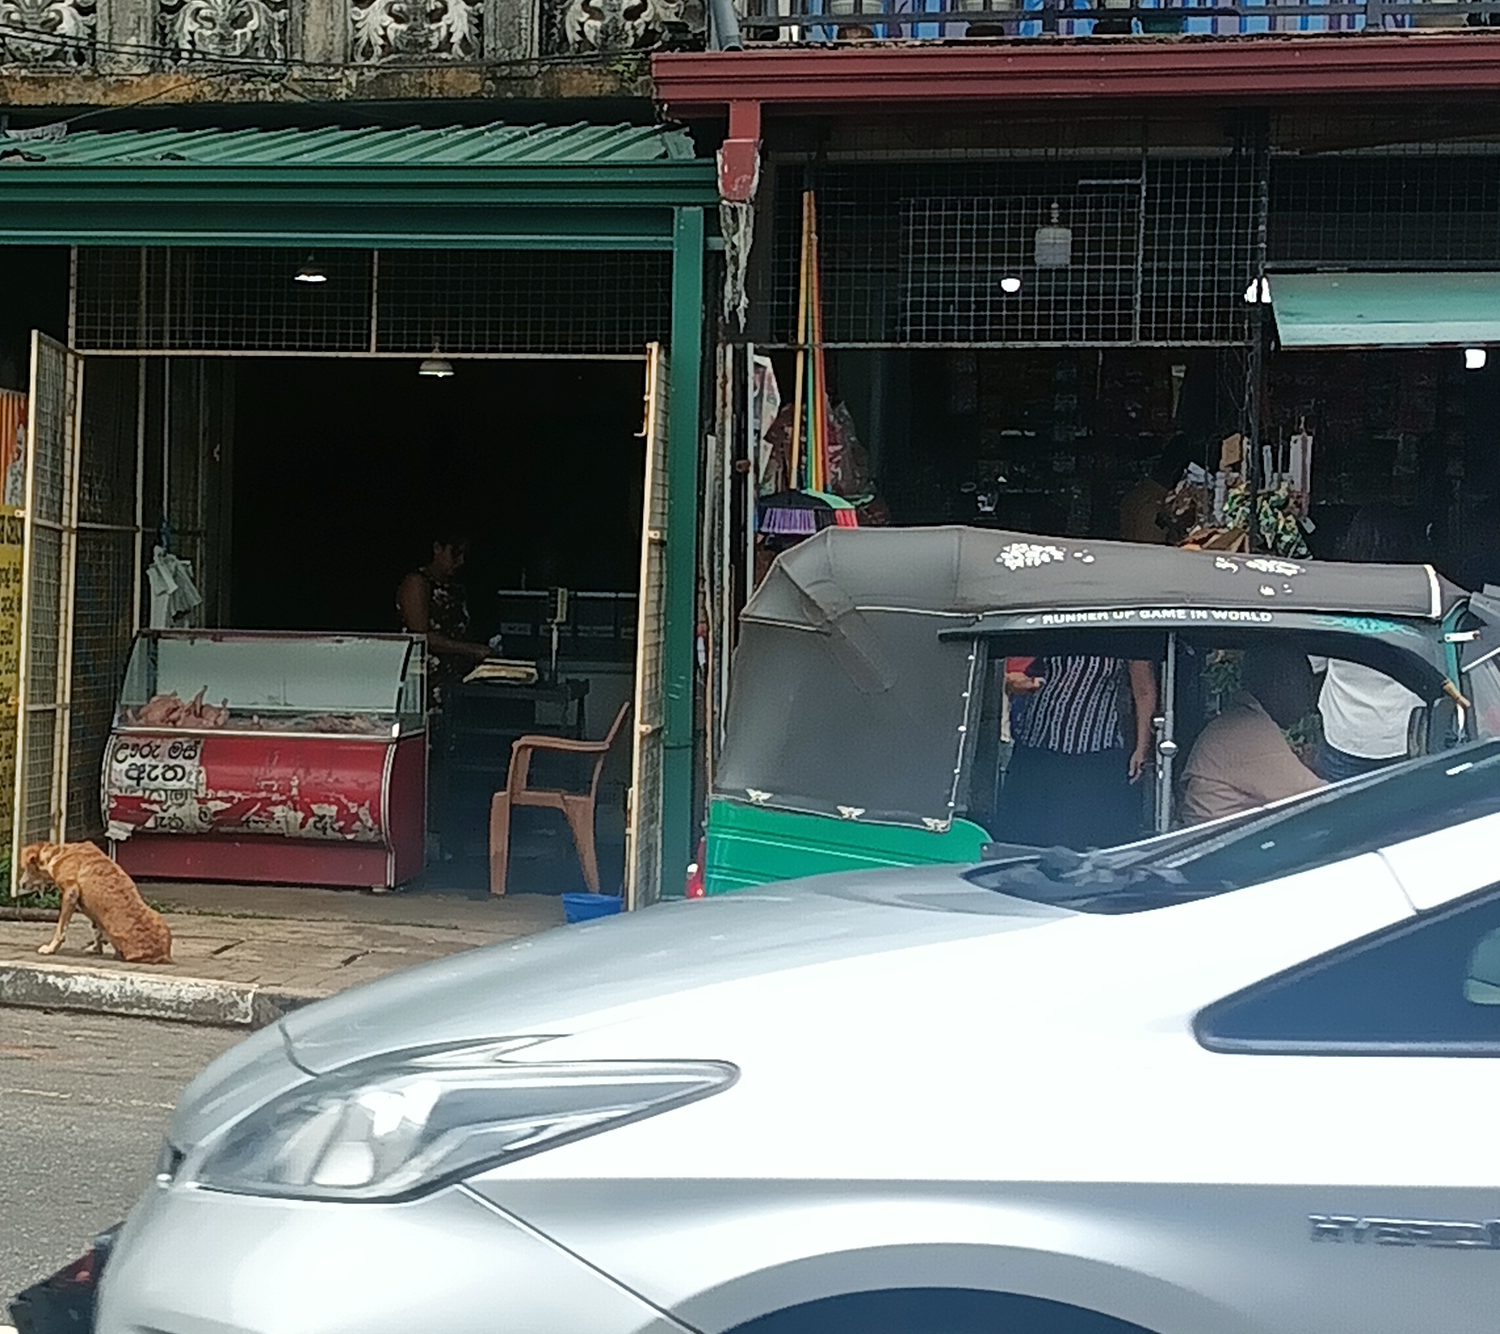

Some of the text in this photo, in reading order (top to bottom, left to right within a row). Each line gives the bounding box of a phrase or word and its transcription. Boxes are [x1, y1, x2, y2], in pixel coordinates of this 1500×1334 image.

[1042, 609, 1273, 625] RUNNER UP GAME IN WORLD
[168, 739, 201, 760] මස්
[124, 763, 186, 787] ඇත
